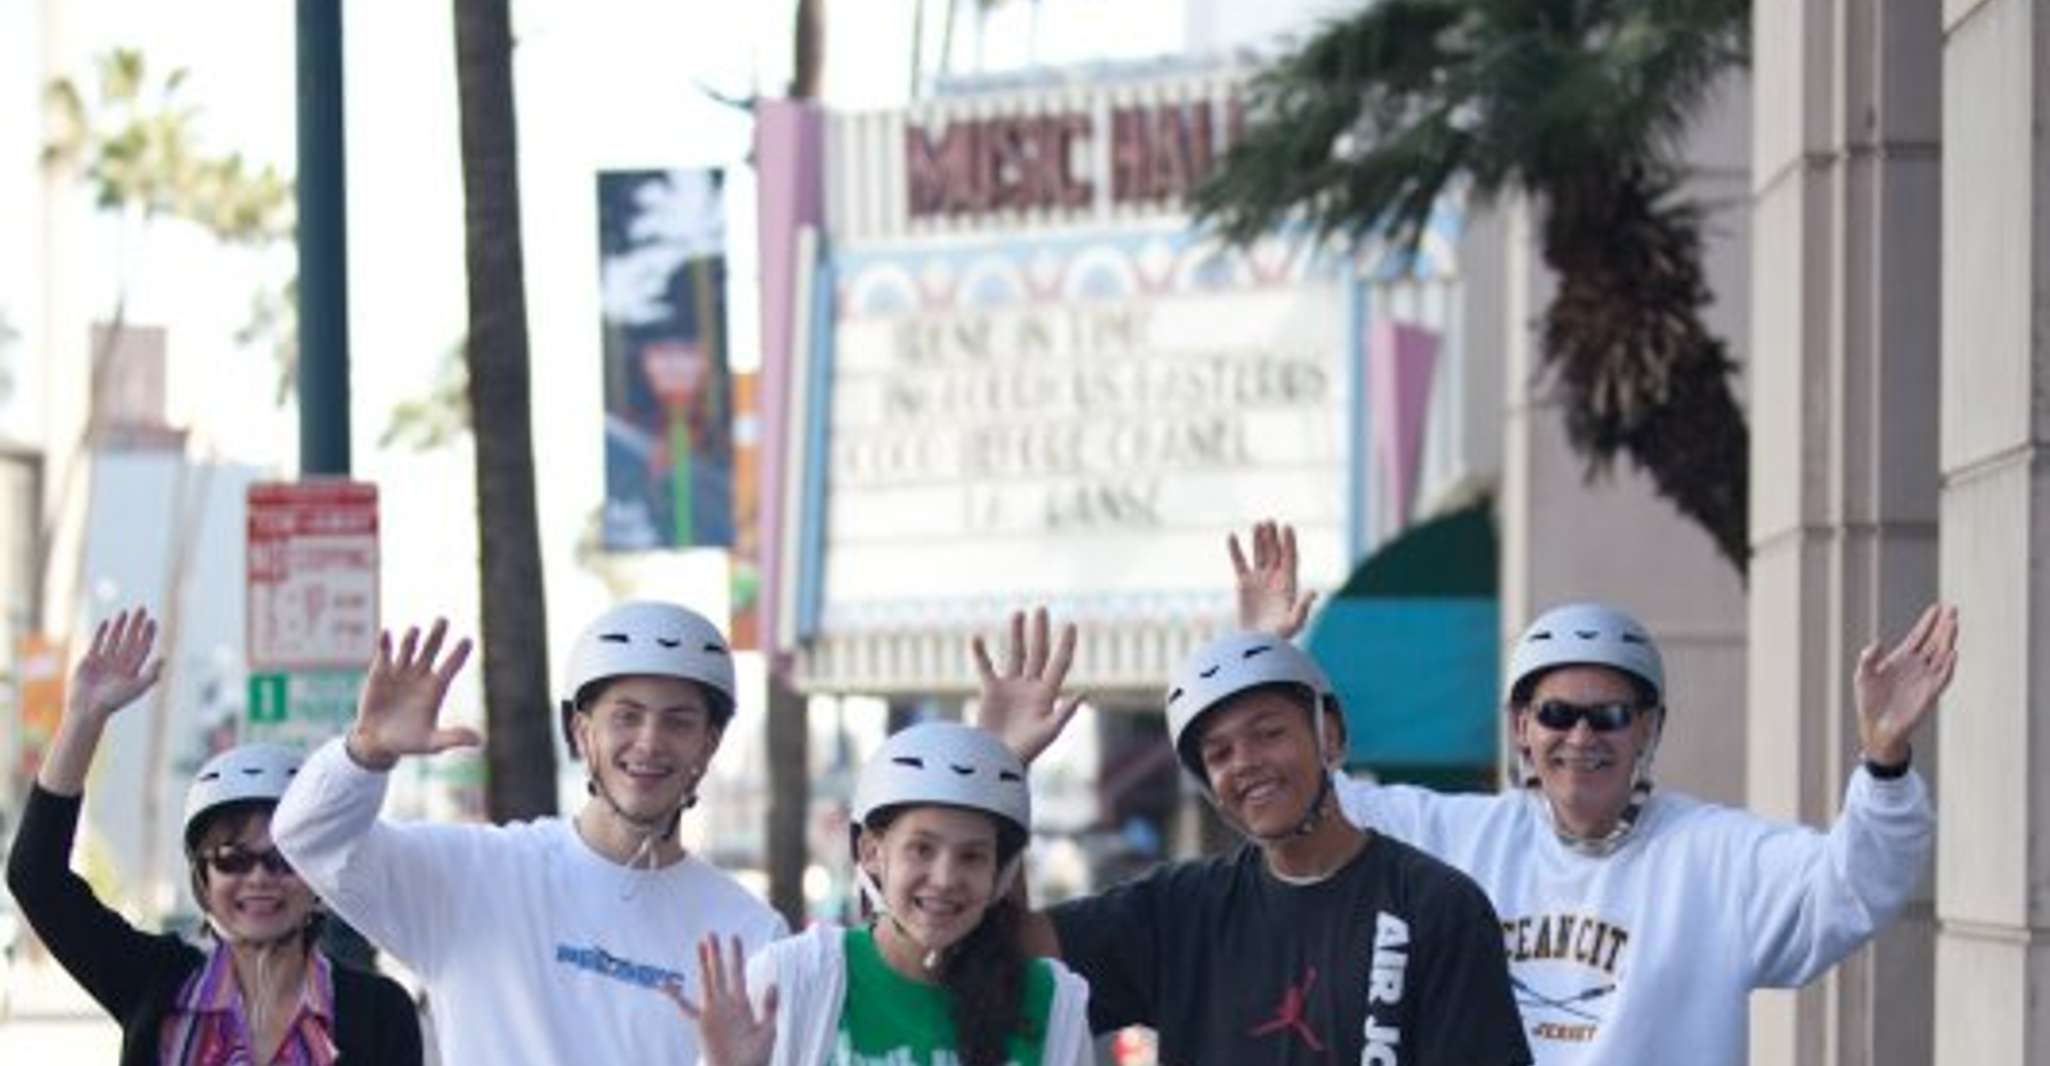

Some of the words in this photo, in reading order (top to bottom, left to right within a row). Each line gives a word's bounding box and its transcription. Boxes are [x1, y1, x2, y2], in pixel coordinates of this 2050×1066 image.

[906, 110, 1094, 218] MUSIC
[1110, 98, 1248, 204] HAL
[1368, 910, 1409, 1006] AIR
[1498, 914, 1576, 962] CEAN
